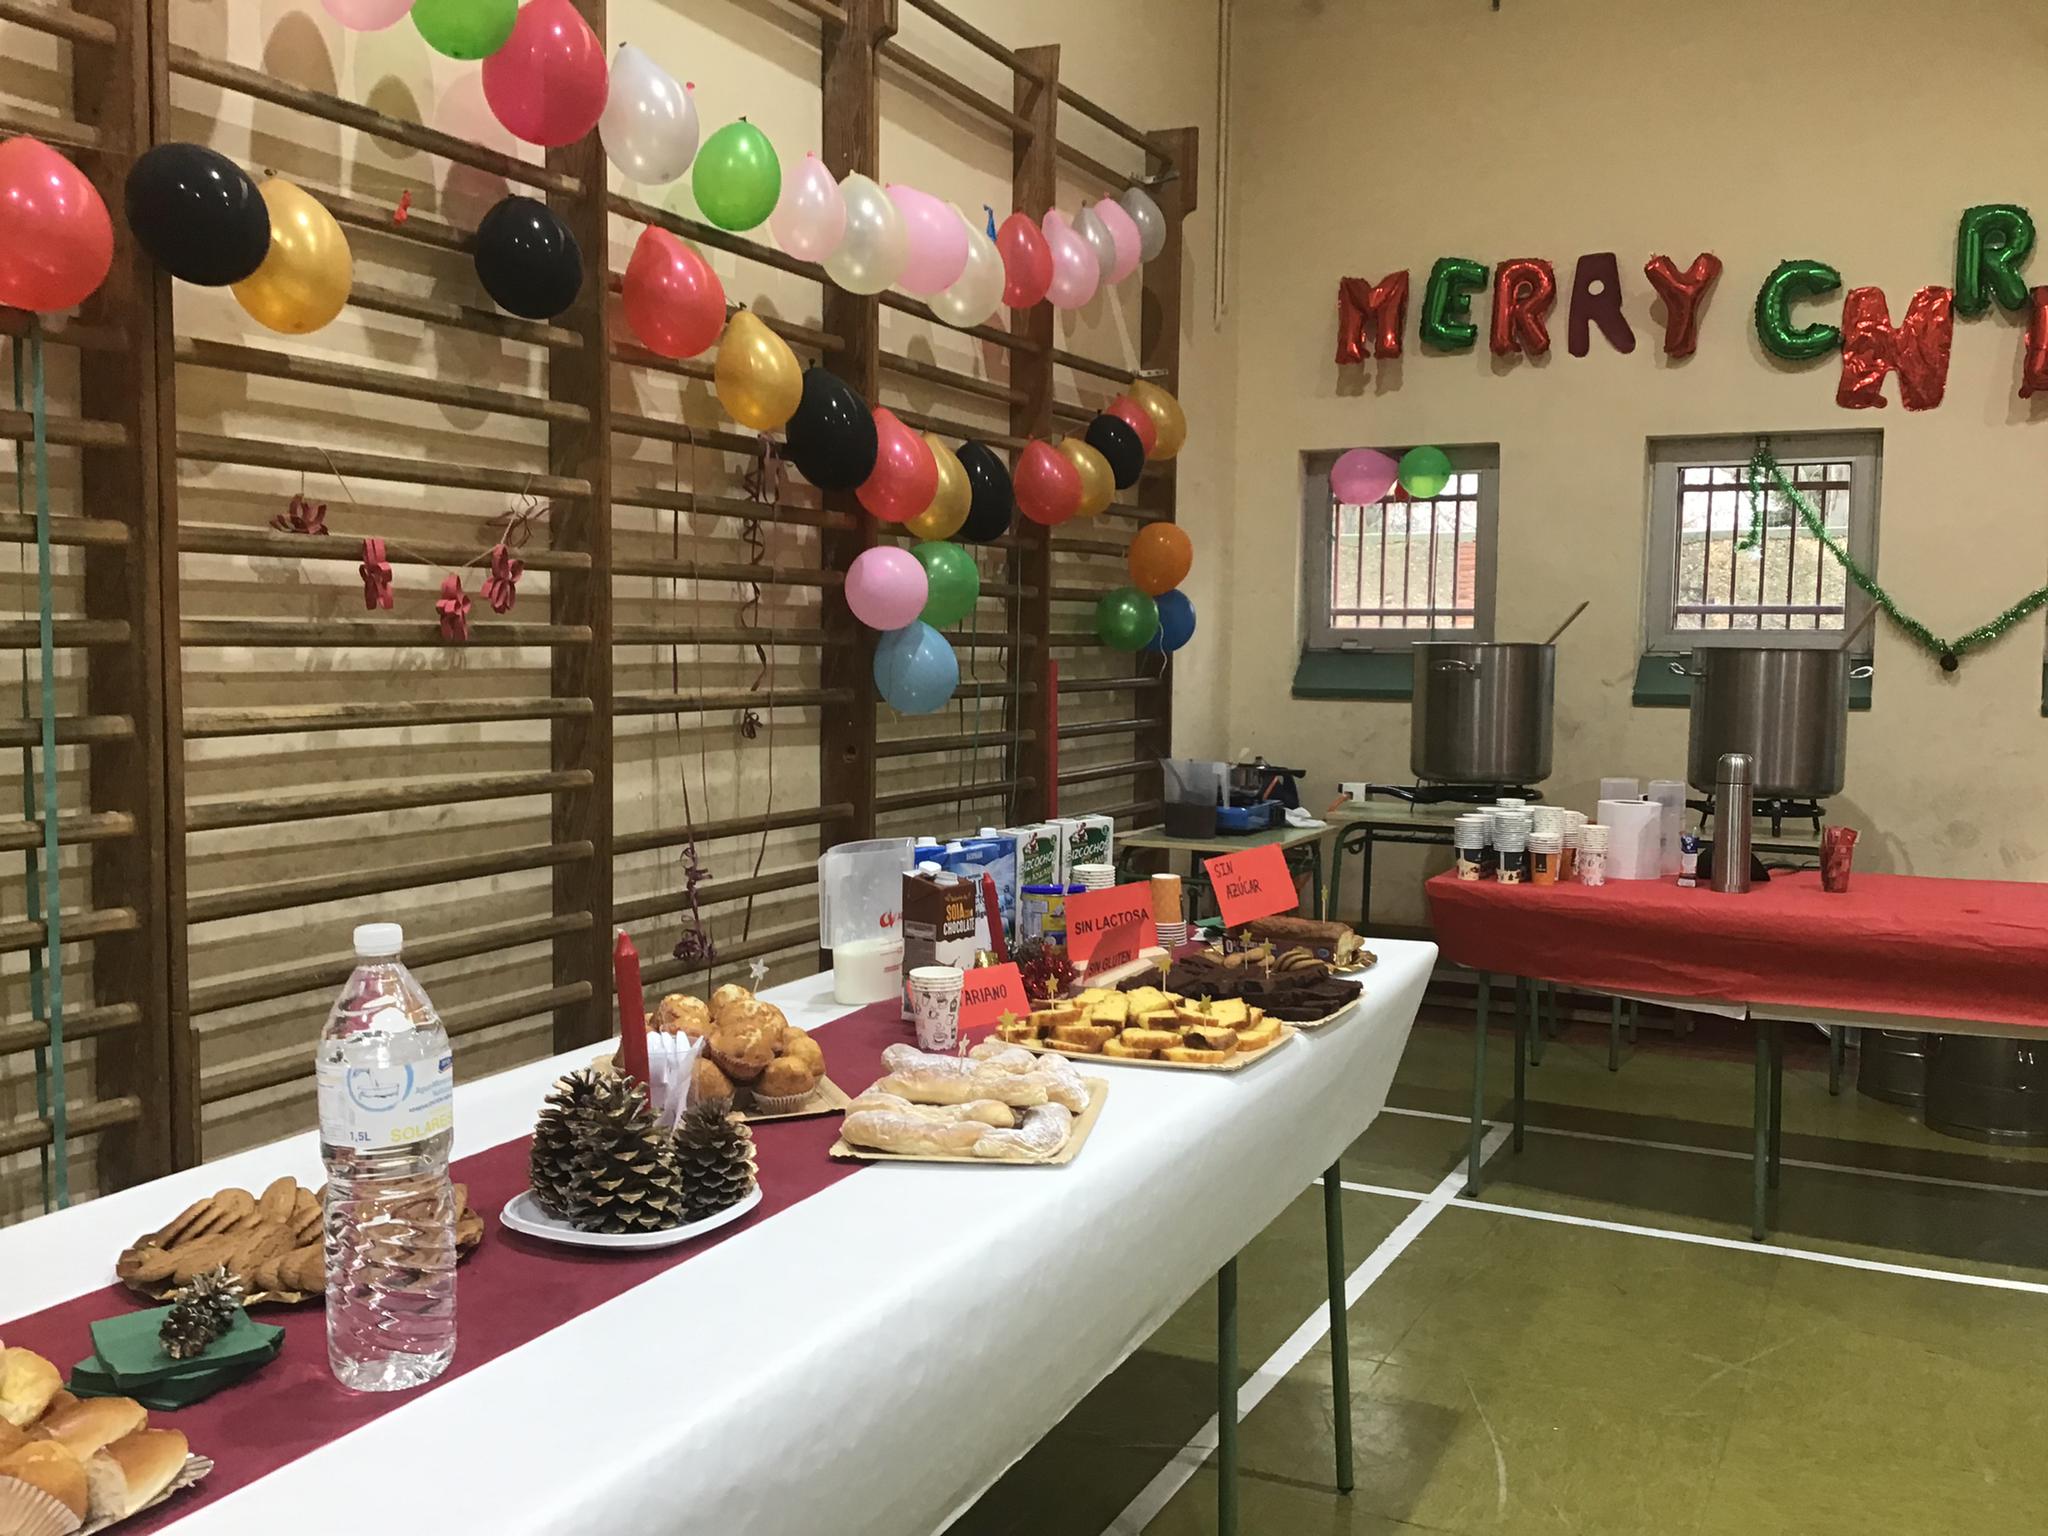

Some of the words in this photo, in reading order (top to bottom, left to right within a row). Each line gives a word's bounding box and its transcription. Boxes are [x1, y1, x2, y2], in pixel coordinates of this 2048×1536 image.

[1335, 252, 1723, 364] MERRY
[1214, 861, 1234, 878] SIN
[1074, 920, 1093, 935] SIN
[1095, 908, 1149, 931] LACTOSA
[960, 984, 1007, 1007] ARIANO
[349, 1131, 371, 1142] 1,5L
